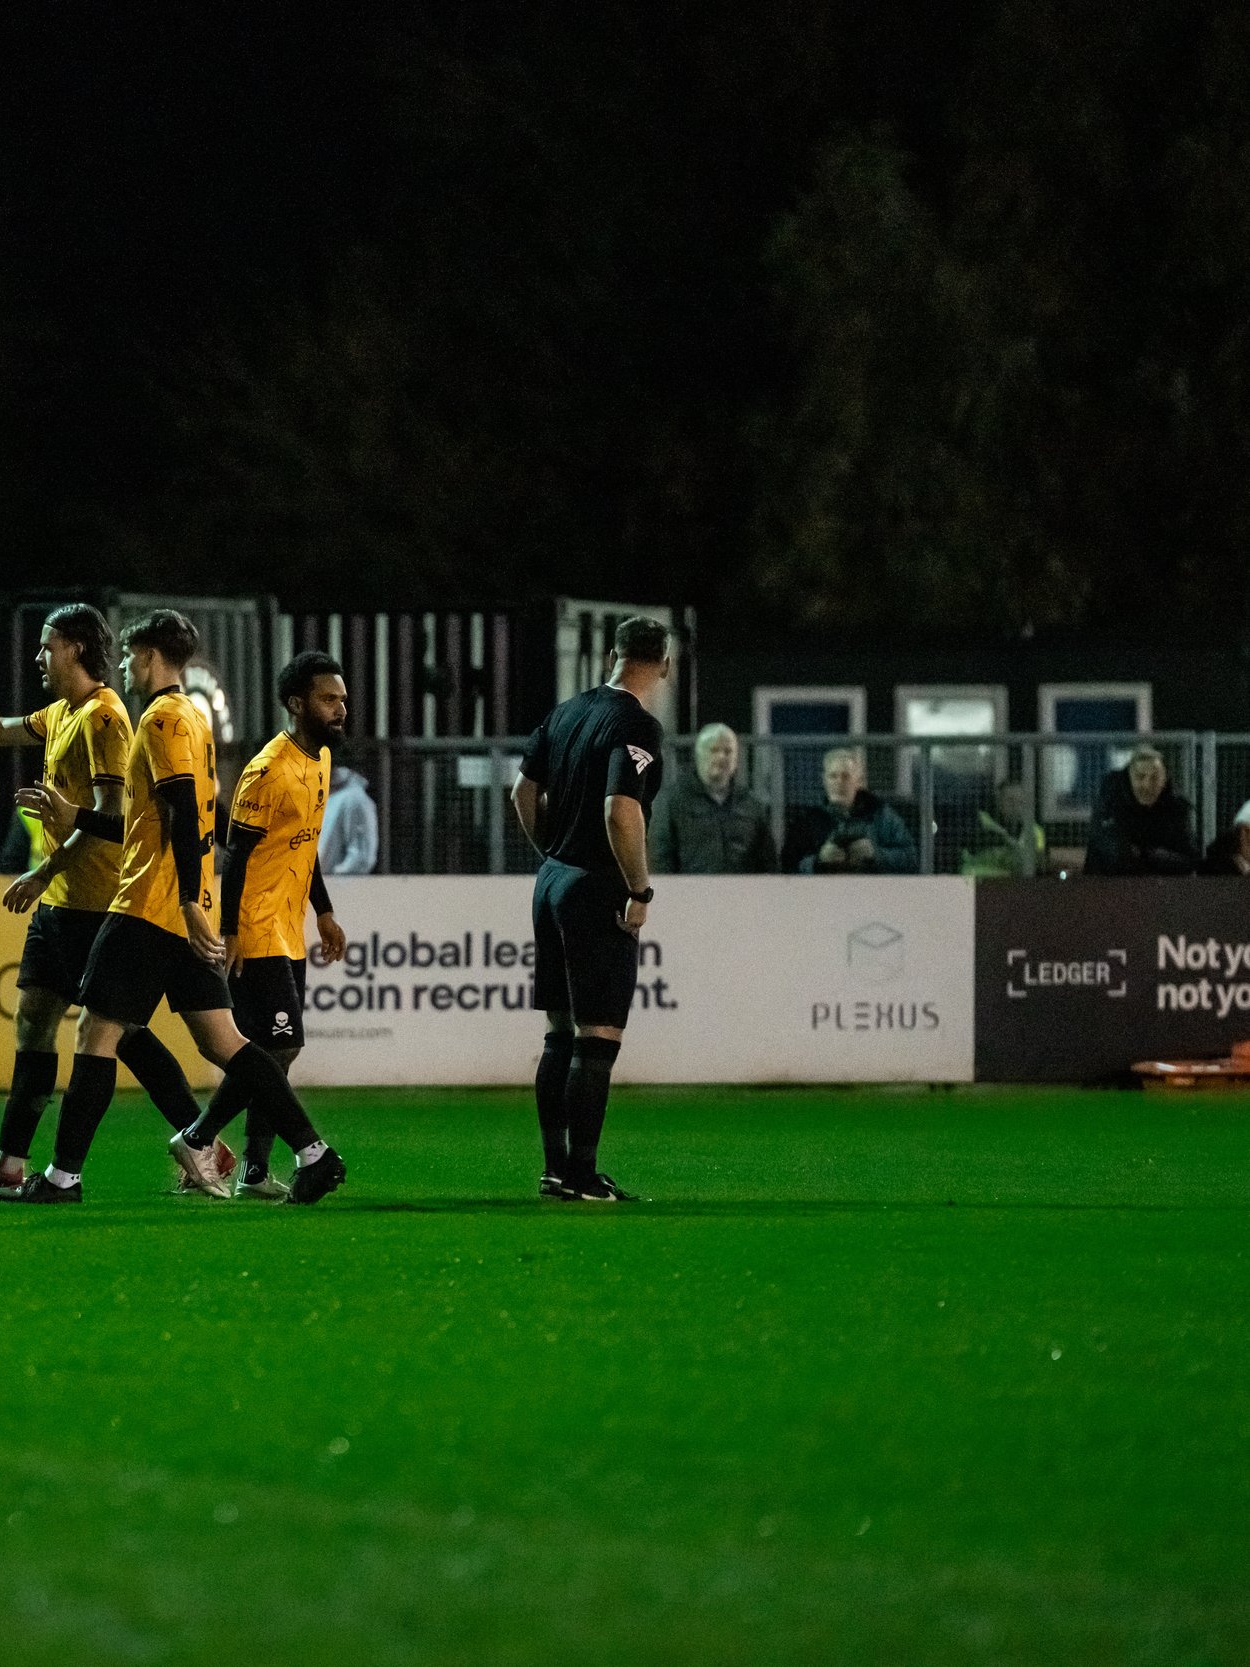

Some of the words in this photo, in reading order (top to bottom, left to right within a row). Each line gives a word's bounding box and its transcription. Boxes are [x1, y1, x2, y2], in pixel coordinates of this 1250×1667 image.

[344, 932, 471, 978] global
[484, 932, 536, 968] lea
[1157, 934, 1221, 971] Not
[1023, 961, 1111, 986] LEDGER
[1156, 977, 1213, 1012] not
[812, 1002, 939, 1031] PLEXUS
